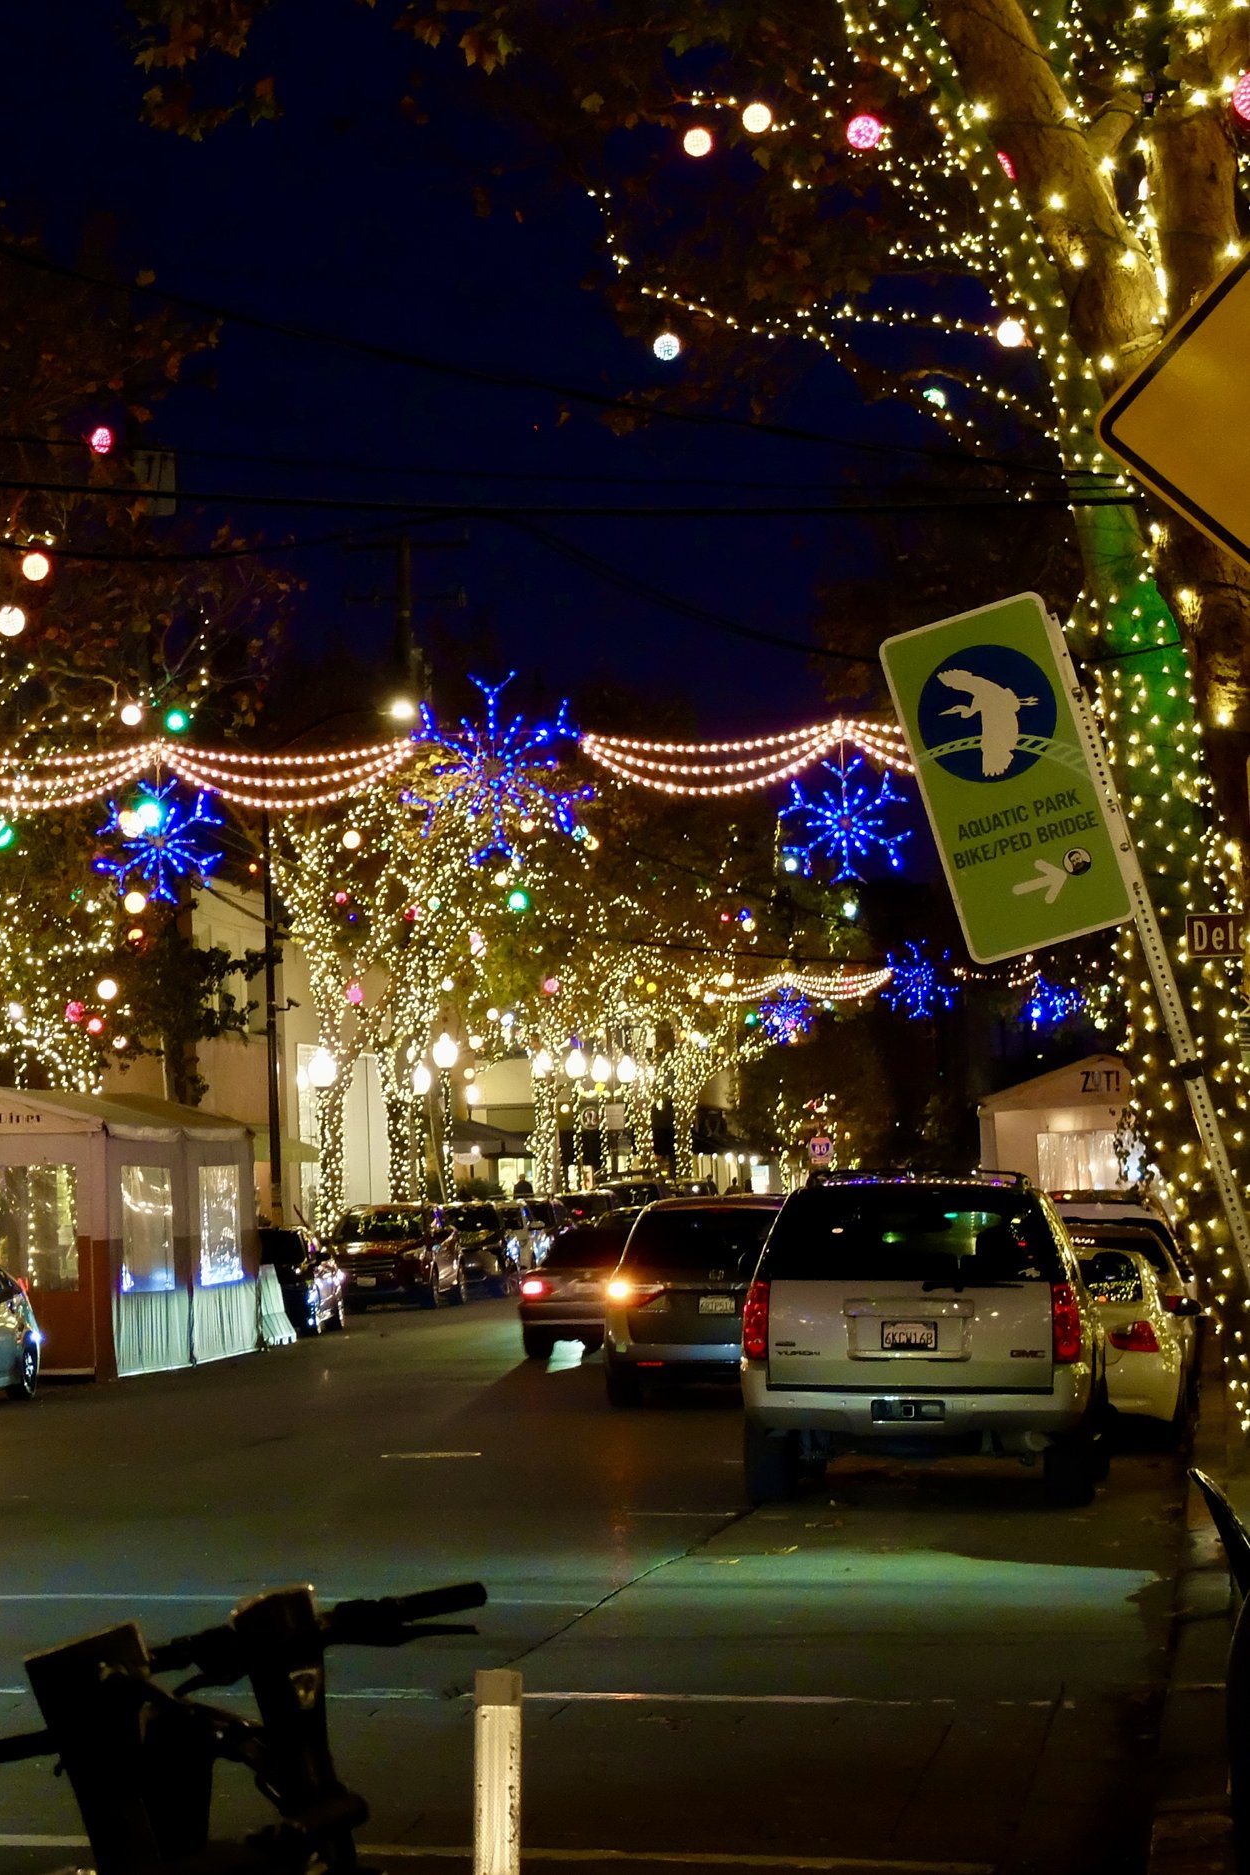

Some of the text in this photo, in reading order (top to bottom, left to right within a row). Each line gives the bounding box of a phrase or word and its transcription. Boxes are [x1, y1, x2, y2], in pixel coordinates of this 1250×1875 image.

[958, 788, 1081, 842] AQUATIC PARK
[953, 810, 1099, 870] BIKE/PED BRIDGE
[1080, 1070, 1120, 1092] ZUT!
[1010, 1349, 1046, 1359] GMC
